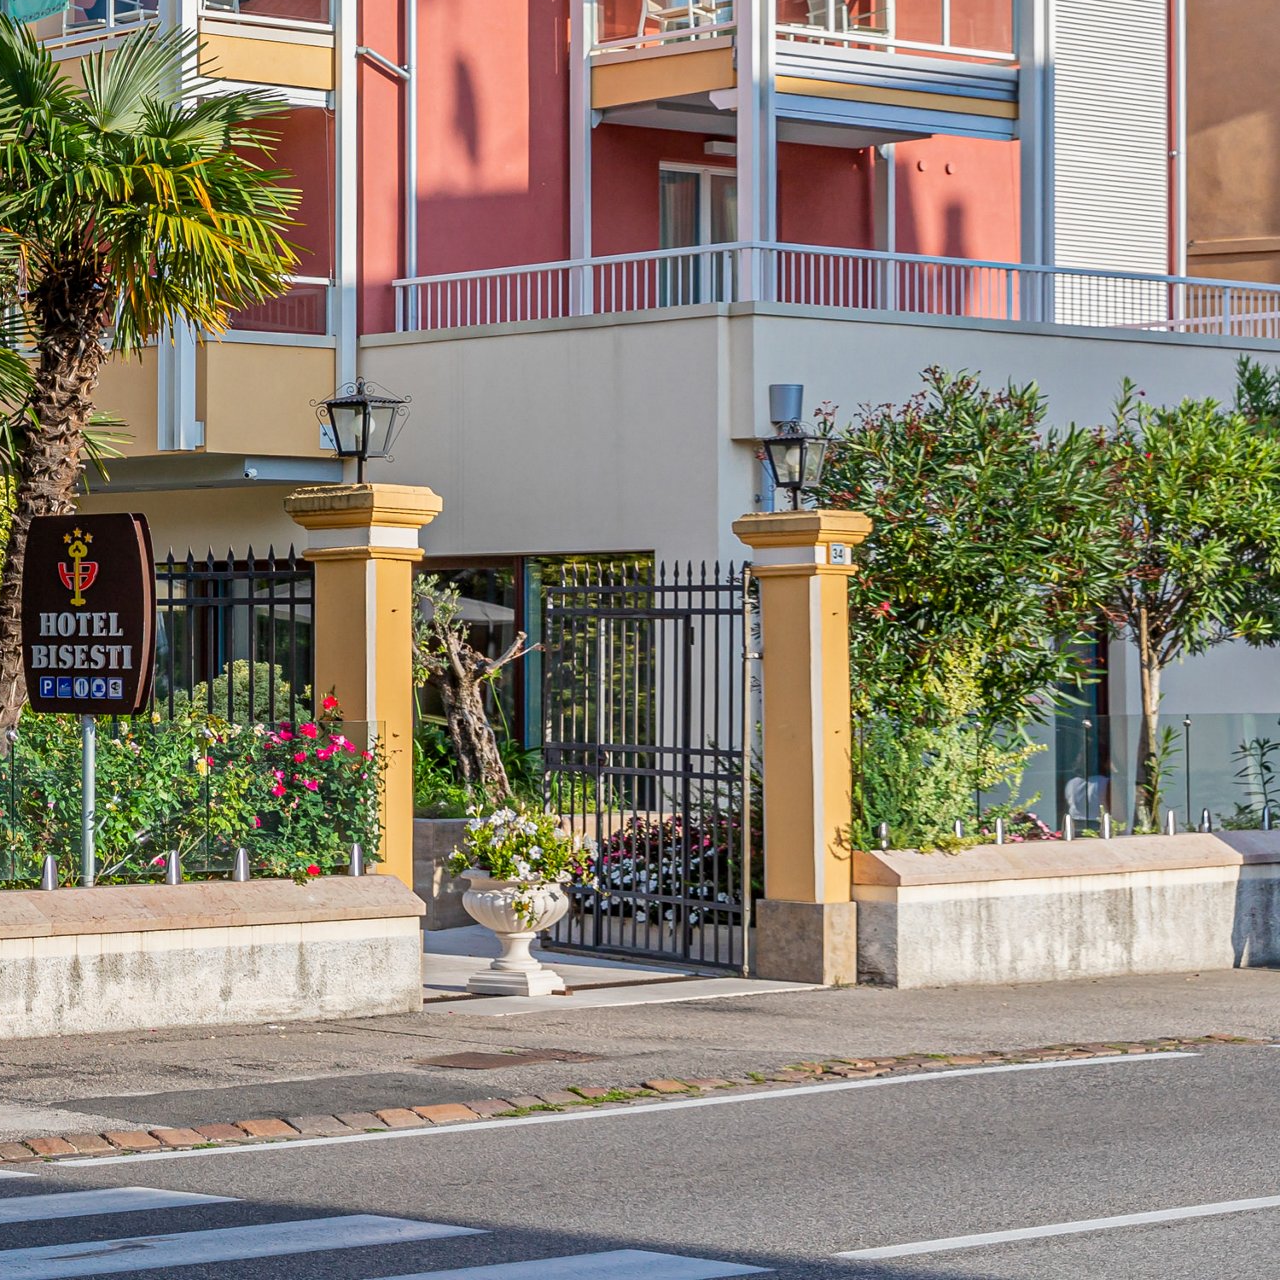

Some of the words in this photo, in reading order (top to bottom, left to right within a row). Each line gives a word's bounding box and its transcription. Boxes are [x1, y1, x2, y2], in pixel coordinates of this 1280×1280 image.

[833, 548, 843, 559] 34
[39, 612, 124, 637] HOTEL
[31, 645, 133, 669] BISESTI
